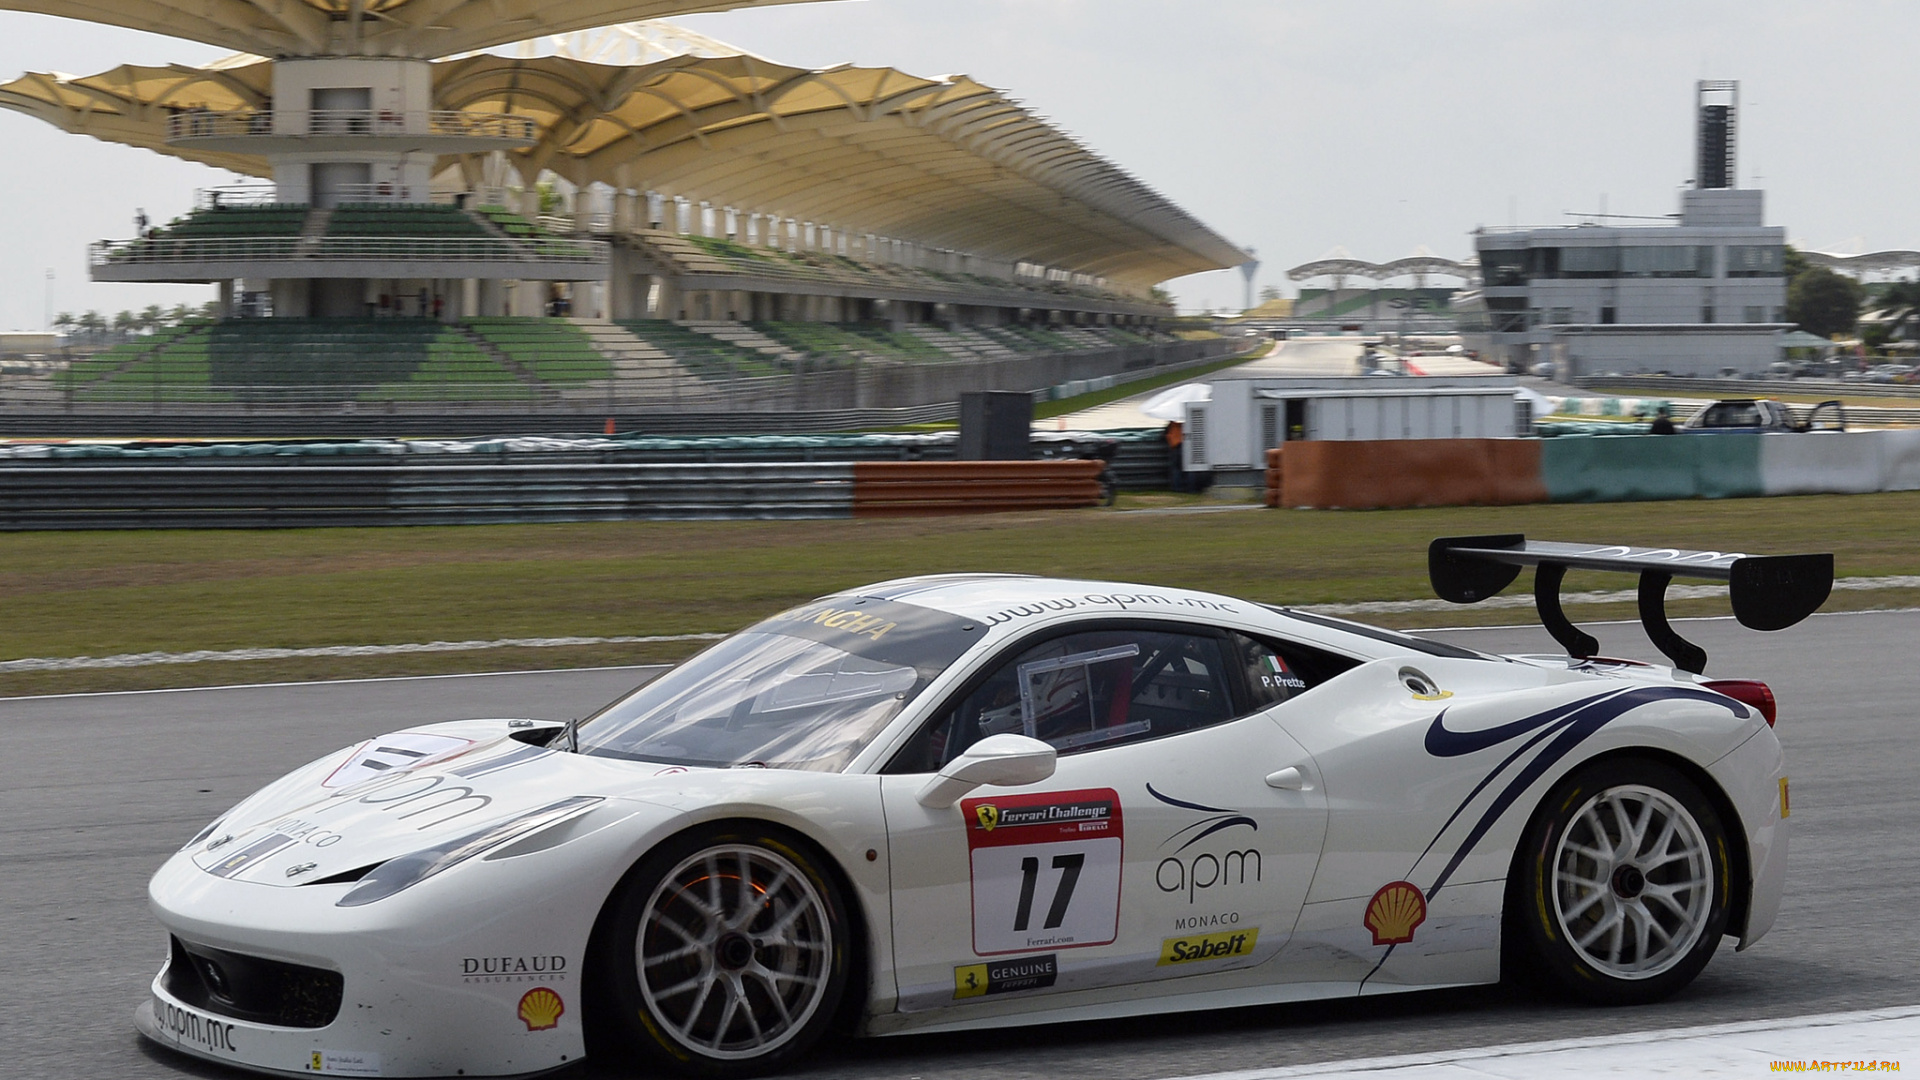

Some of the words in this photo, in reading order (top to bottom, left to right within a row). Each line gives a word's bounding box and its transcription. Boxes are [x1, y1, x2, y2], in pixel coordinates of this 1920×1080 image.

[987, 593, 1239, 627] www.apm.mc
[1261, 675, 1274, 687] P.
[1274, 675, 1306, 688] Prette
[1001, 809, 1047, 823] Ferrari
[1048, 806, 1107, 819] Challenge
[1079, 821, 1108, 832] PIRELLI
[1156, 848, 1261, 904] apm
[1013, 853, 1085, 932] 17
[1175, 912, 1239, 930] MONACO
[1027, 936, 1075, 947] Ferrari.com
[1170, 934, 1246, 962] Sabelt
[463, 956, 566, 974] DUFAUD
[991, 962, 1053, 979] GENUINE
[463, 975, 566, 984] ASSURANCES
